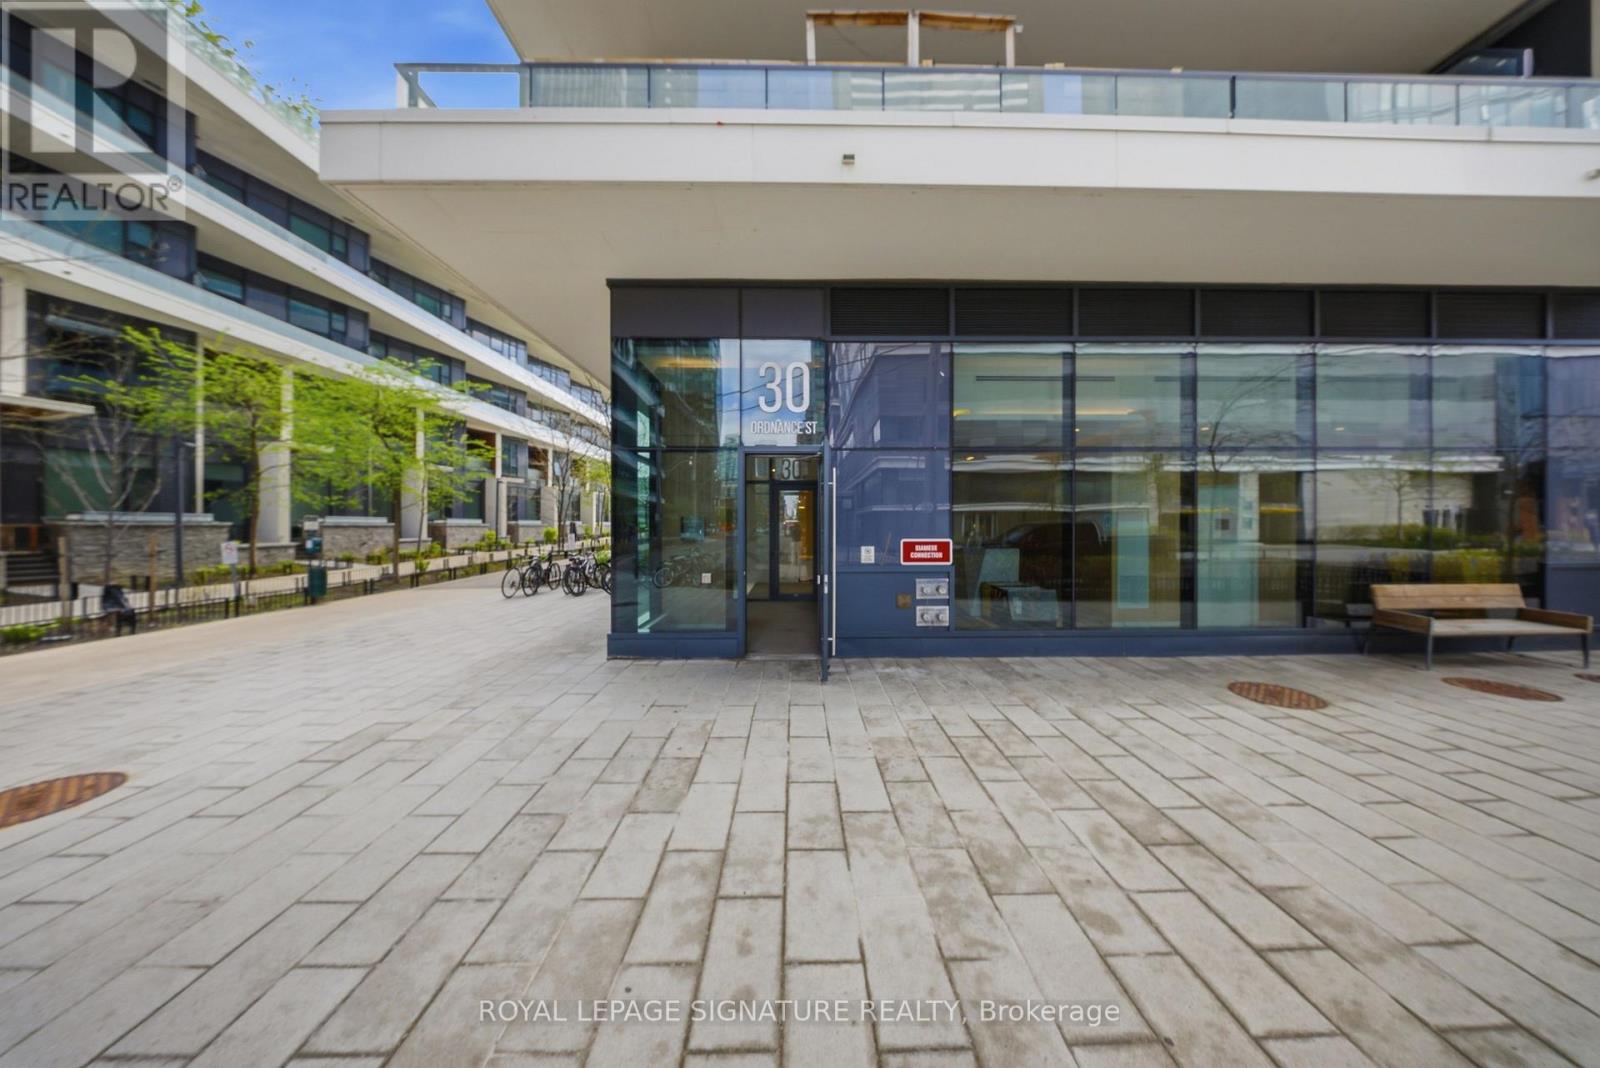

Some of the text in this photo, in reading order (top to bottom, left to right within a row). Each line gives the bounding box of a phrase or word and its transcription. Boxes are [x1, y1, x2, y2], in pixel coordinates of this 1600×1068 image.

[758, 361, 810, 413] 30
[751, 421, 818, 434] ORDNANCE ST
[782, 458, 801, 480] 30
